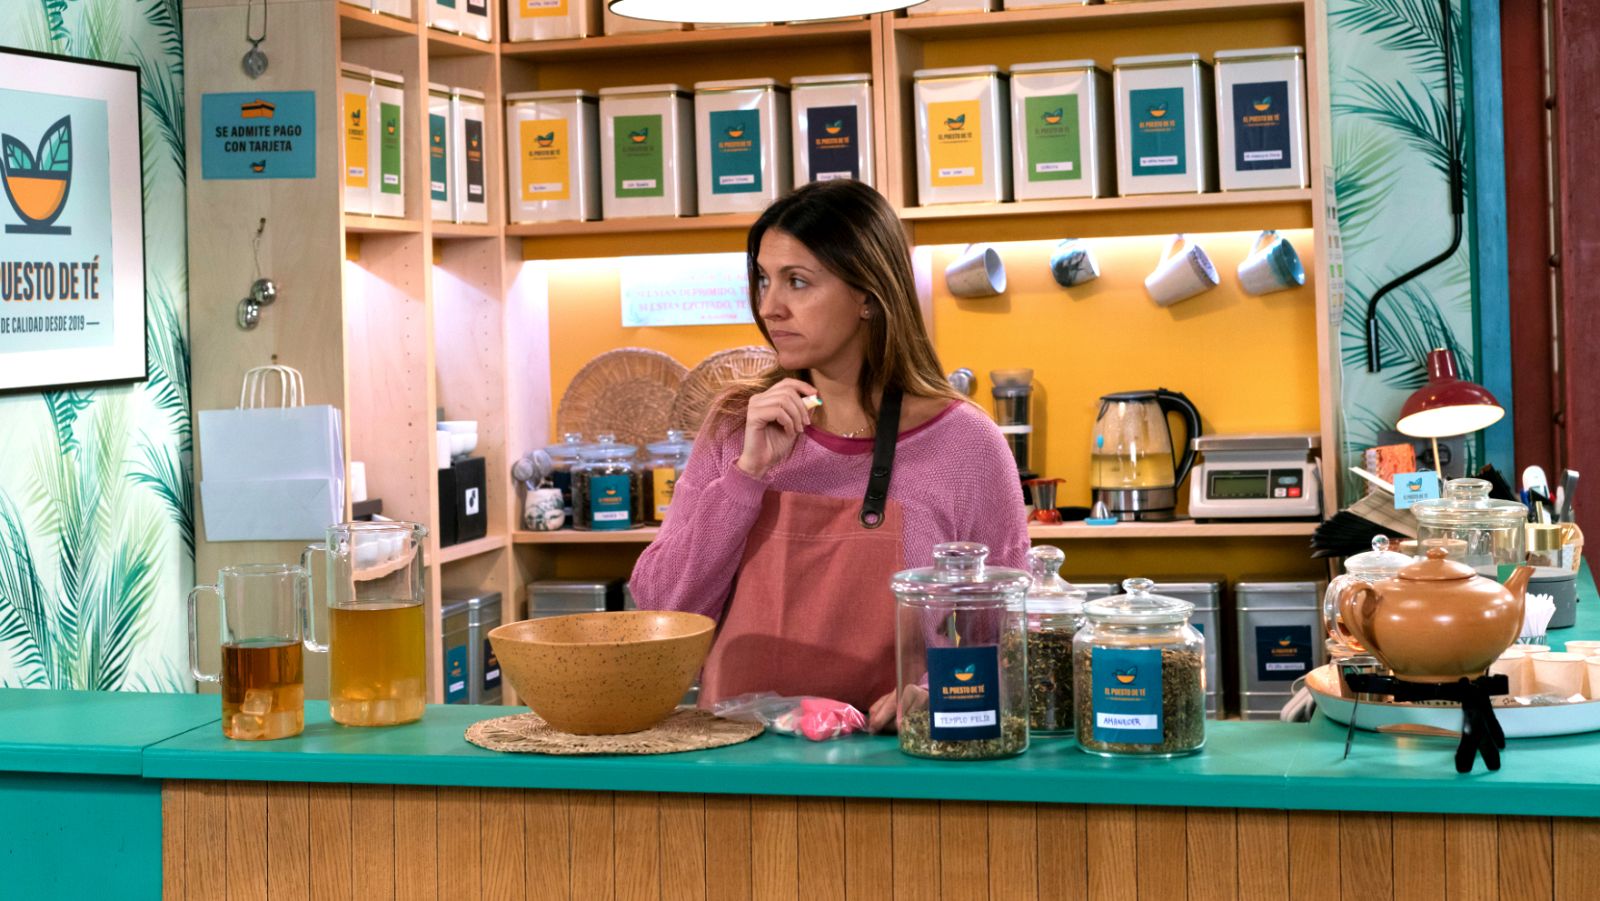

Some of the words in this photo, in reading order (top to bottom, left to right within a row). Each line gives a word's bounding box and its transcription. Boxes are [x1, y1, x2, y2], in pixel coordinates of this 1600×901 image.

[215, 126, 228, 138] SE
[231, 126, 271, 137] ADMITE
[274, 125, 302, 136] PAGO
[224, 141, 246, 152] CON
[250, 140, 292, 152] TARJETA
[0, 261, 55, 301] UESTO
[59, 262, 79, 300] DE
[82, 255, 99, 300] TÉ
[1, 320, 10, 334] DE
[12, 317, 43, 333] CALIDAD
[45, 316, 67, 332] DESDE
[69, 315, 85, 331] 2019
[940, 716, 967, 724] TEMPLO
[1103, 717, 1141, 726] AMANECER
